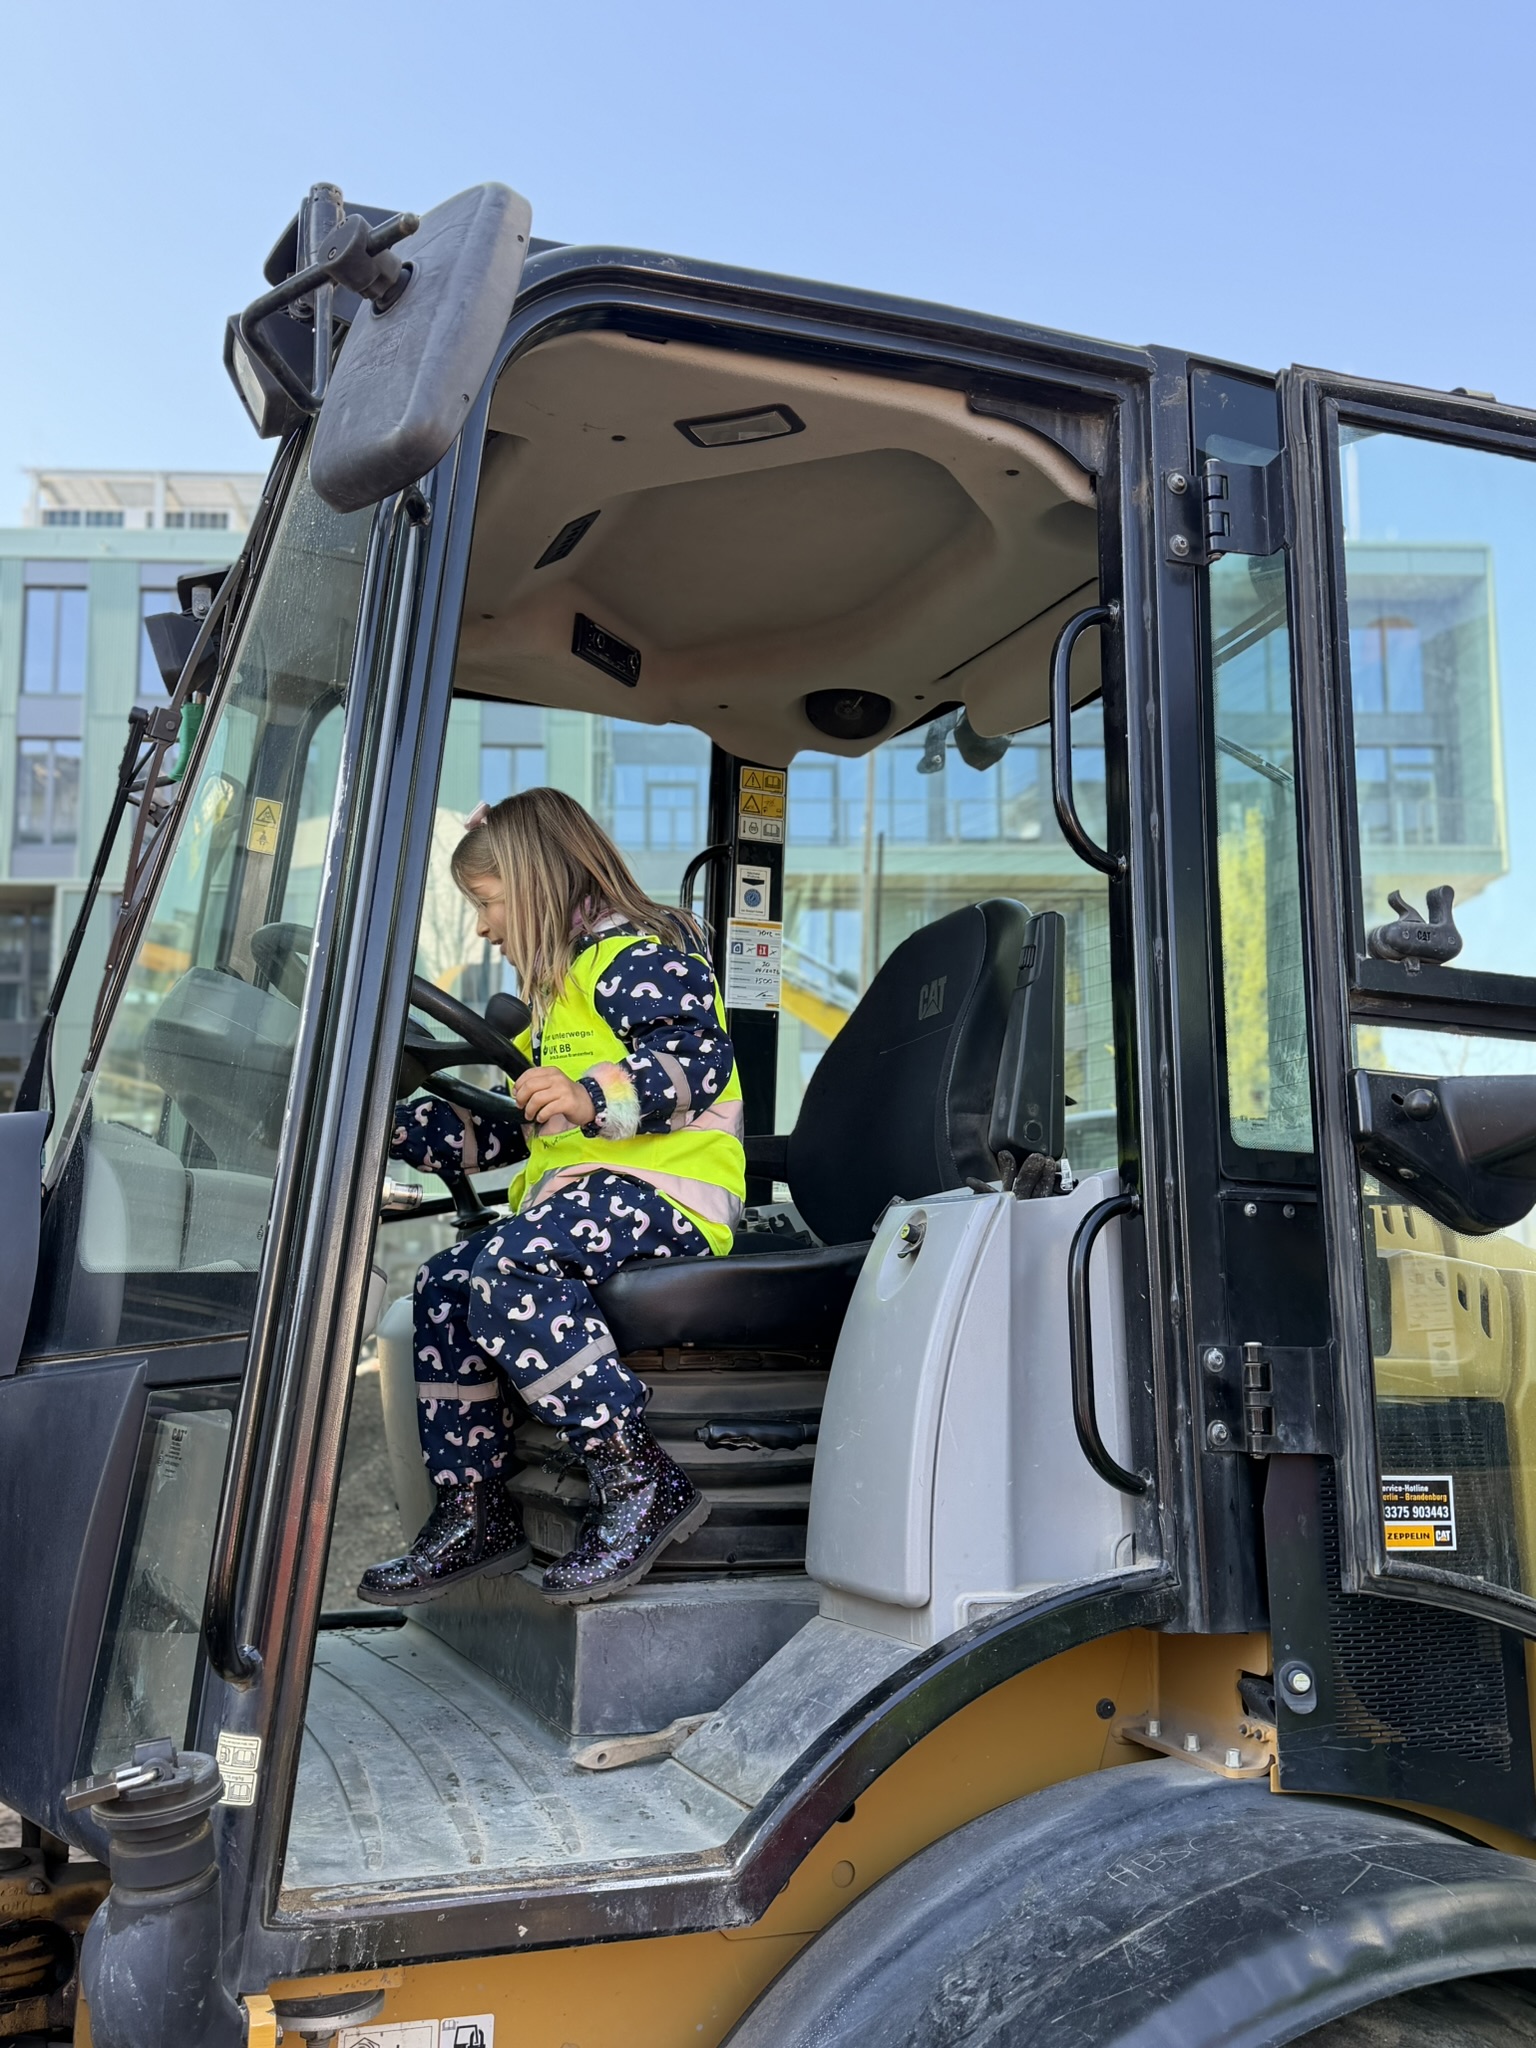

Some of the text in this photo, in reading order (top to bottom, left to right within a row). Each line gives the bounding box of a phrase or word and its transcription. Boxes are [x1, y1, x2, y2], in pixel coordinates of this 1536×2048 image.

[1417, 930, 1431, 941] CAT
[918, 975, 948, 1021] CAT
[559, 1043, 571, 1053] BB
[1382, 1484, 1429, 1492] ervice-Hotline
[1382, 1493, 1398, 1501] erlin
[1405, 1493, 1447, 1502] Brandenburg
[1384, 1506, 1449, 1519] 3375 903443
[1387, 1530, 1451, 1541] ZEPPELIN CAT
